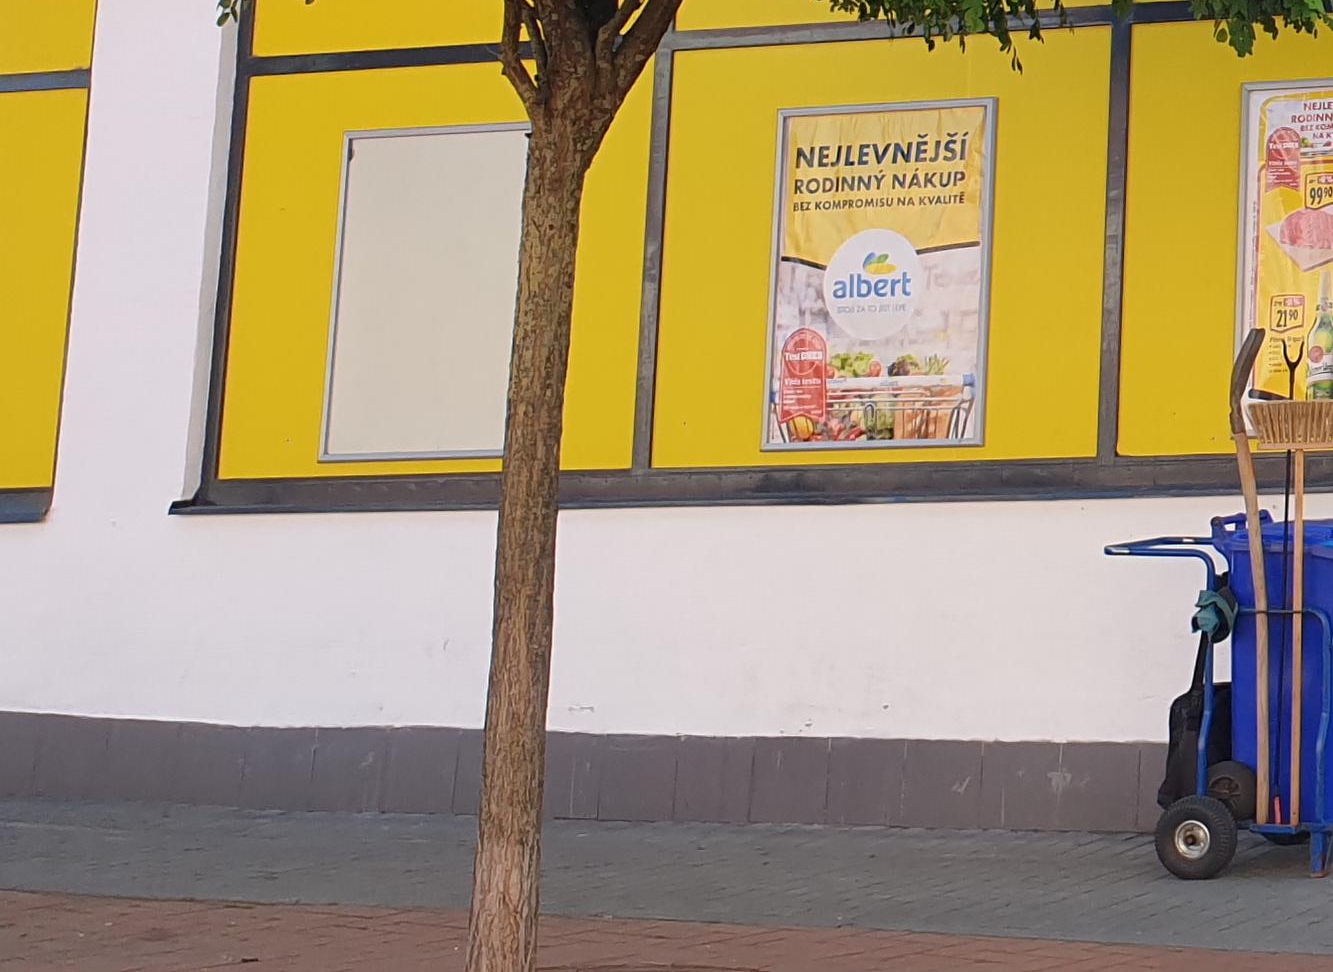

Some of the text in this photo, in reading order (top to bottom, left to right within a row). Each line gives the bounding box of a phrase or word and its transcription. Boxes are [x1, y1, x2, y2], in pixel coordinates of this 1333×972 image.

[795, 131, 970, 169] NEJLEVNĚJŠÍ
[793, 168, 966, 195] RODINNÝ NÁKUP
[793, 201, 811, 213] BEZ
[896, 196, 916, 207] NA
[832, 271, 912, 299] albert
